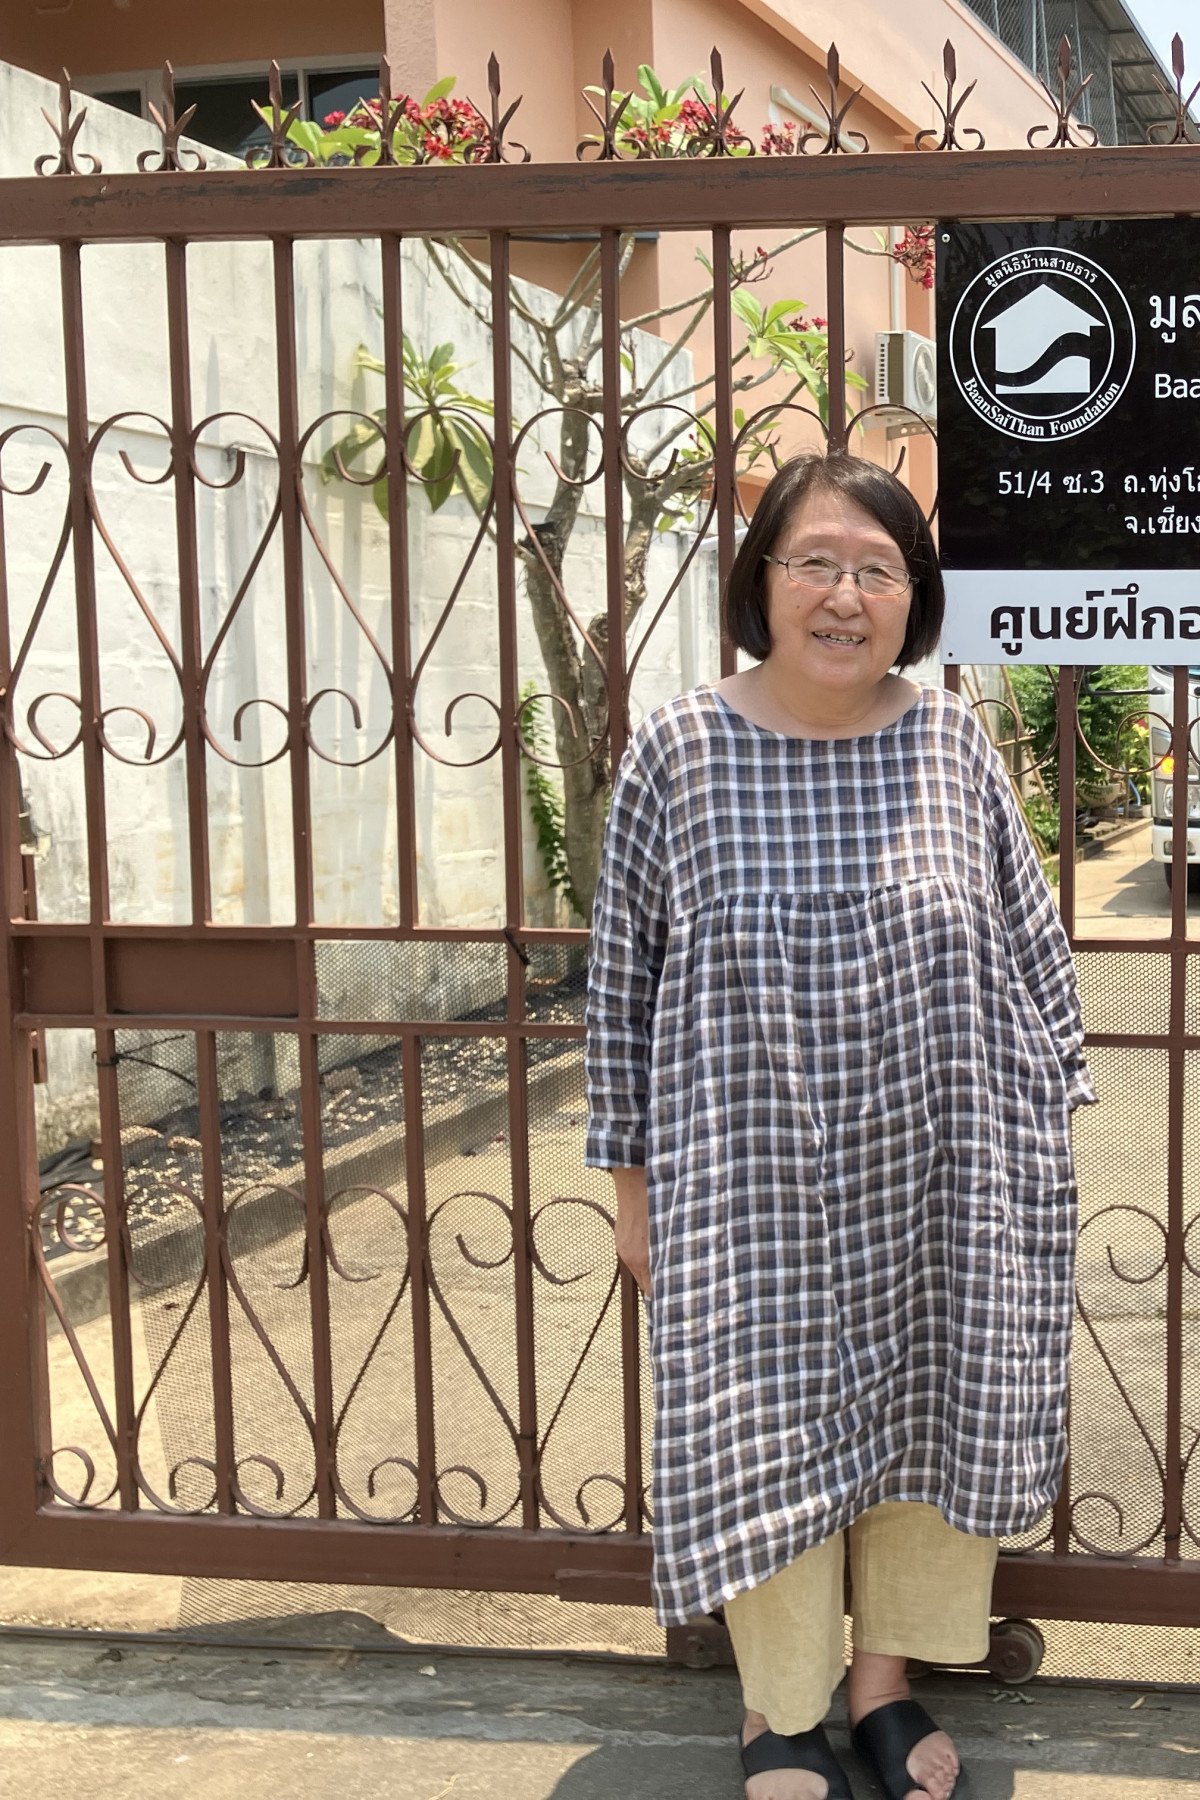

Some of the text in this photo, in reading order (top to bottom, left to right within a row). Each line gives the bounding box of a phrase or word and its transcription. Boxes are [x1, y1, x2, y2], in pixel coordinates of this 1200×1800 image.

[984, 253, 1098, 288] มูลนิธิบ้านสายธาร
[963, 376, 1121, 436] BaanSaiThan Foundation
[998, 470, 1052, 499] 51/4
[1062, 469, 1105, 494] ซ.3
